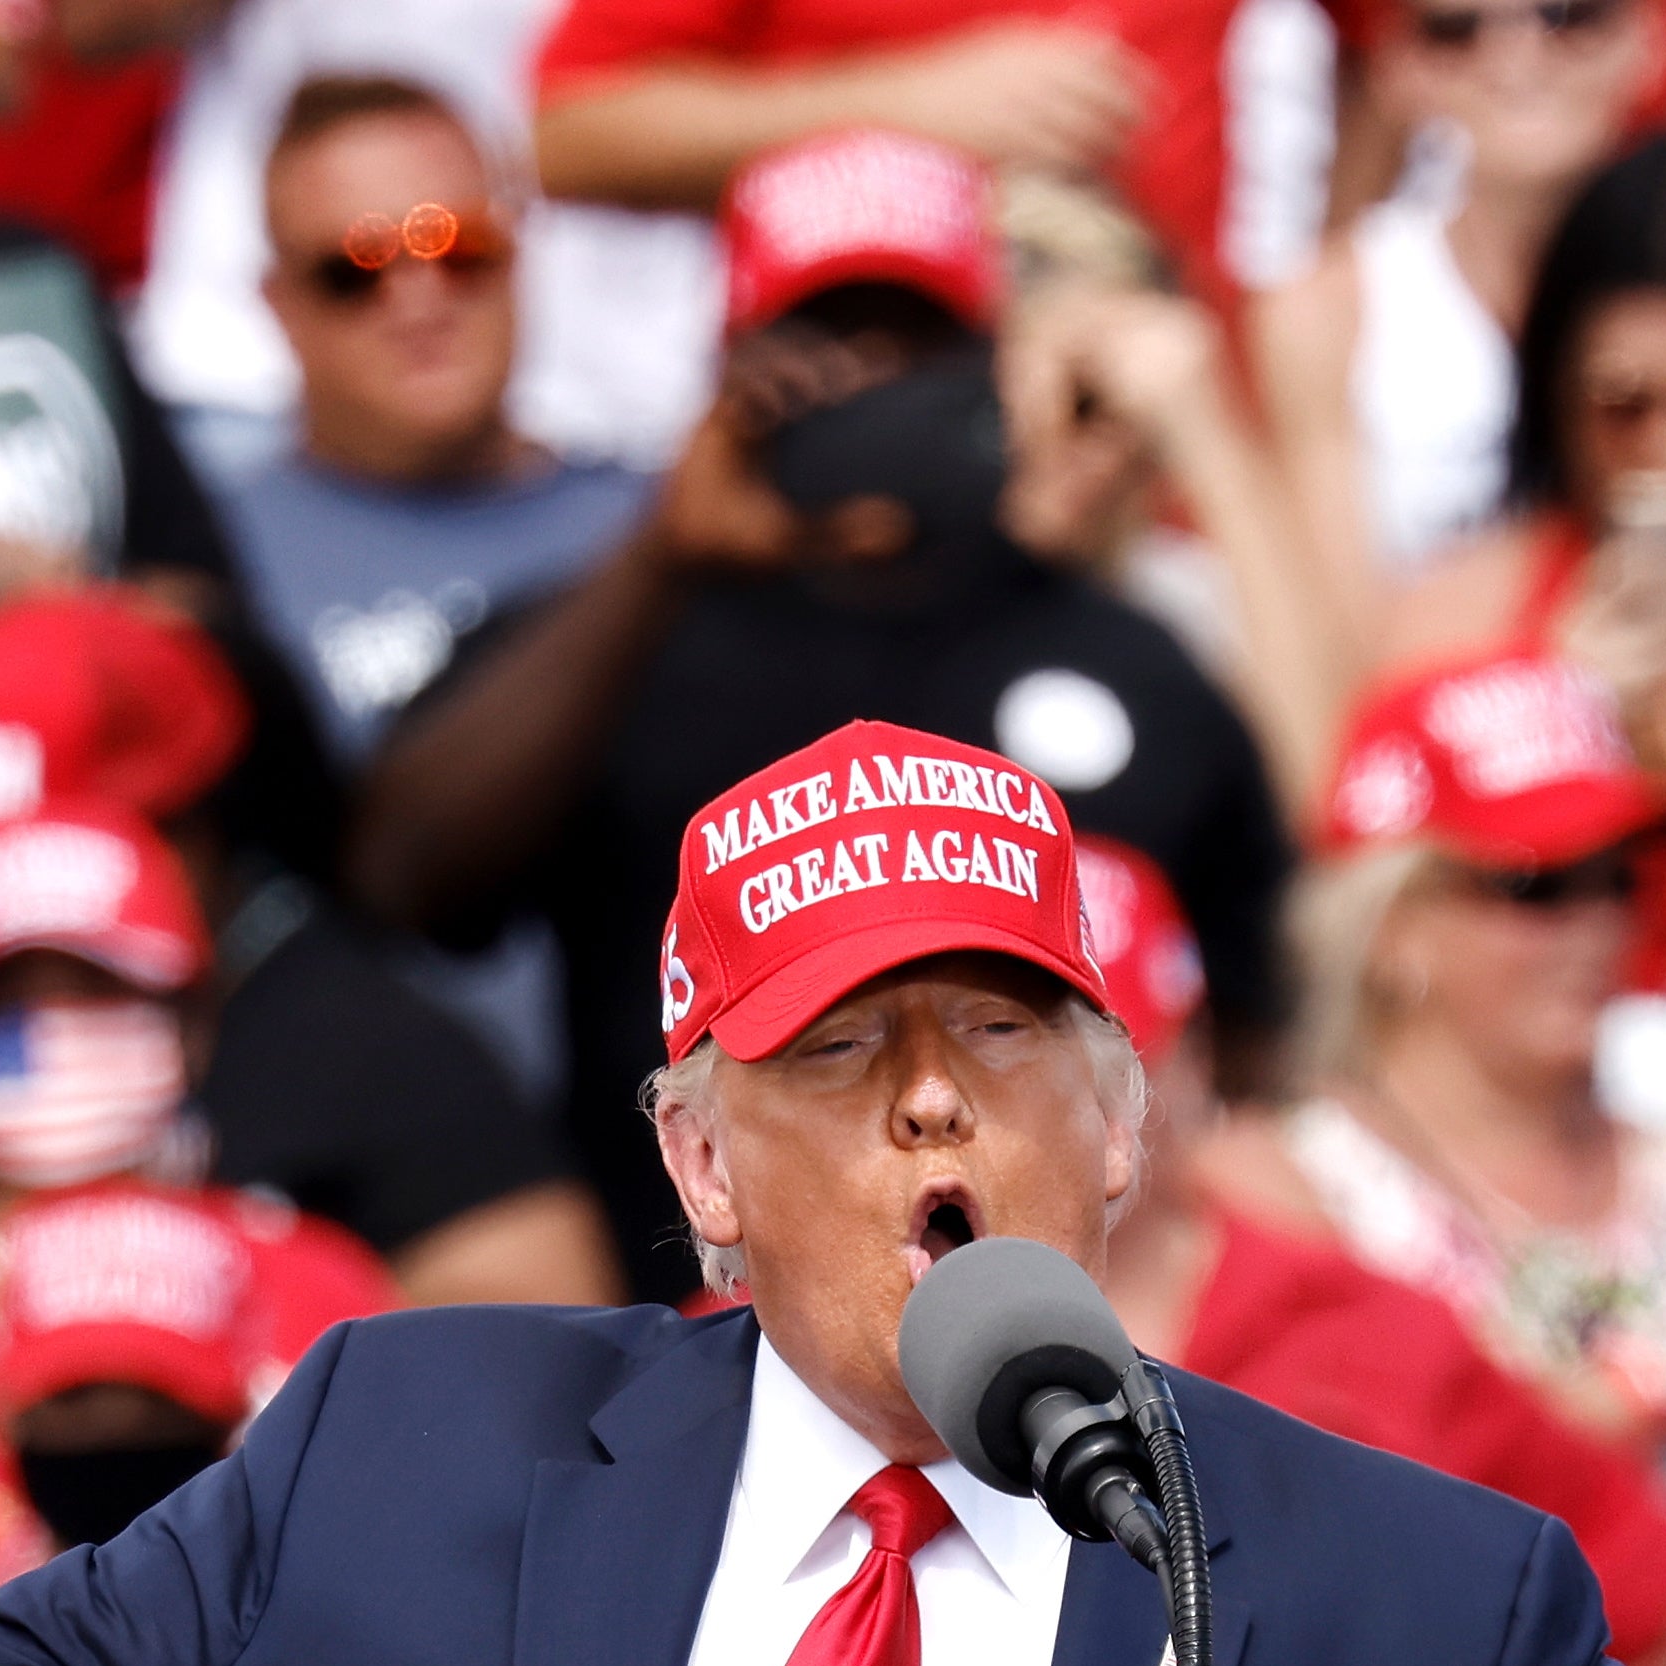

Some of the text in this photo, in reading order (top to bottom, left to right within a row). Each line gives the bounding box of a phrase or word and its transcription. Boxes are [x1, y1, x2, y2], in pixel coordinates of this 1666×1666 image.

[701, 756, 1058, 874] MAKE AMERICA
[739, 830, 1038, 933] GREAT AGAIN
